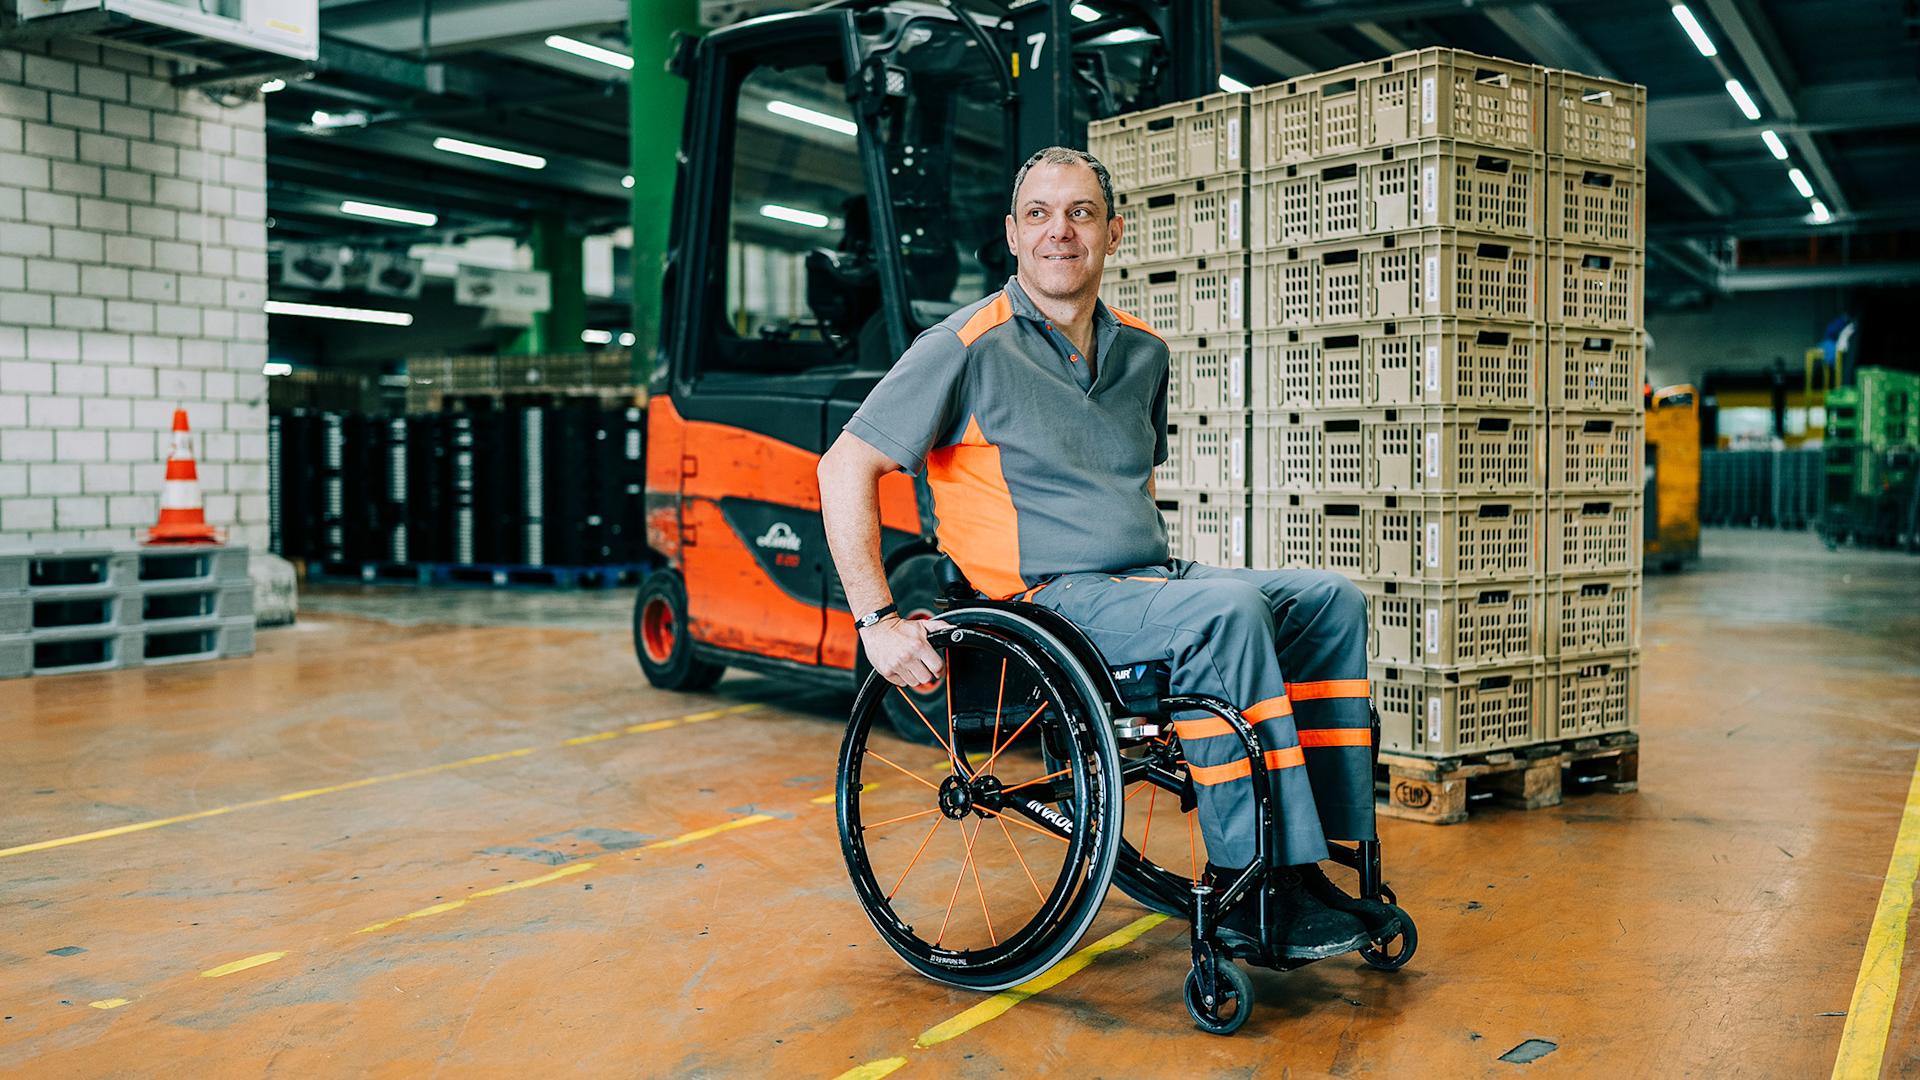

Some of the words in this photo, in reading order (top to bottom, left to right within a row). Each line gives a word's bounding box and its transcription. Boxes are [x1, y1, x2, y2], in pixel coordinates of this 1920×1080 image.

[1026, 32, 1046, 70] 7
[1112, 668, 1131, 681] AIR
[1402, 785, 1424, 804] EUR
